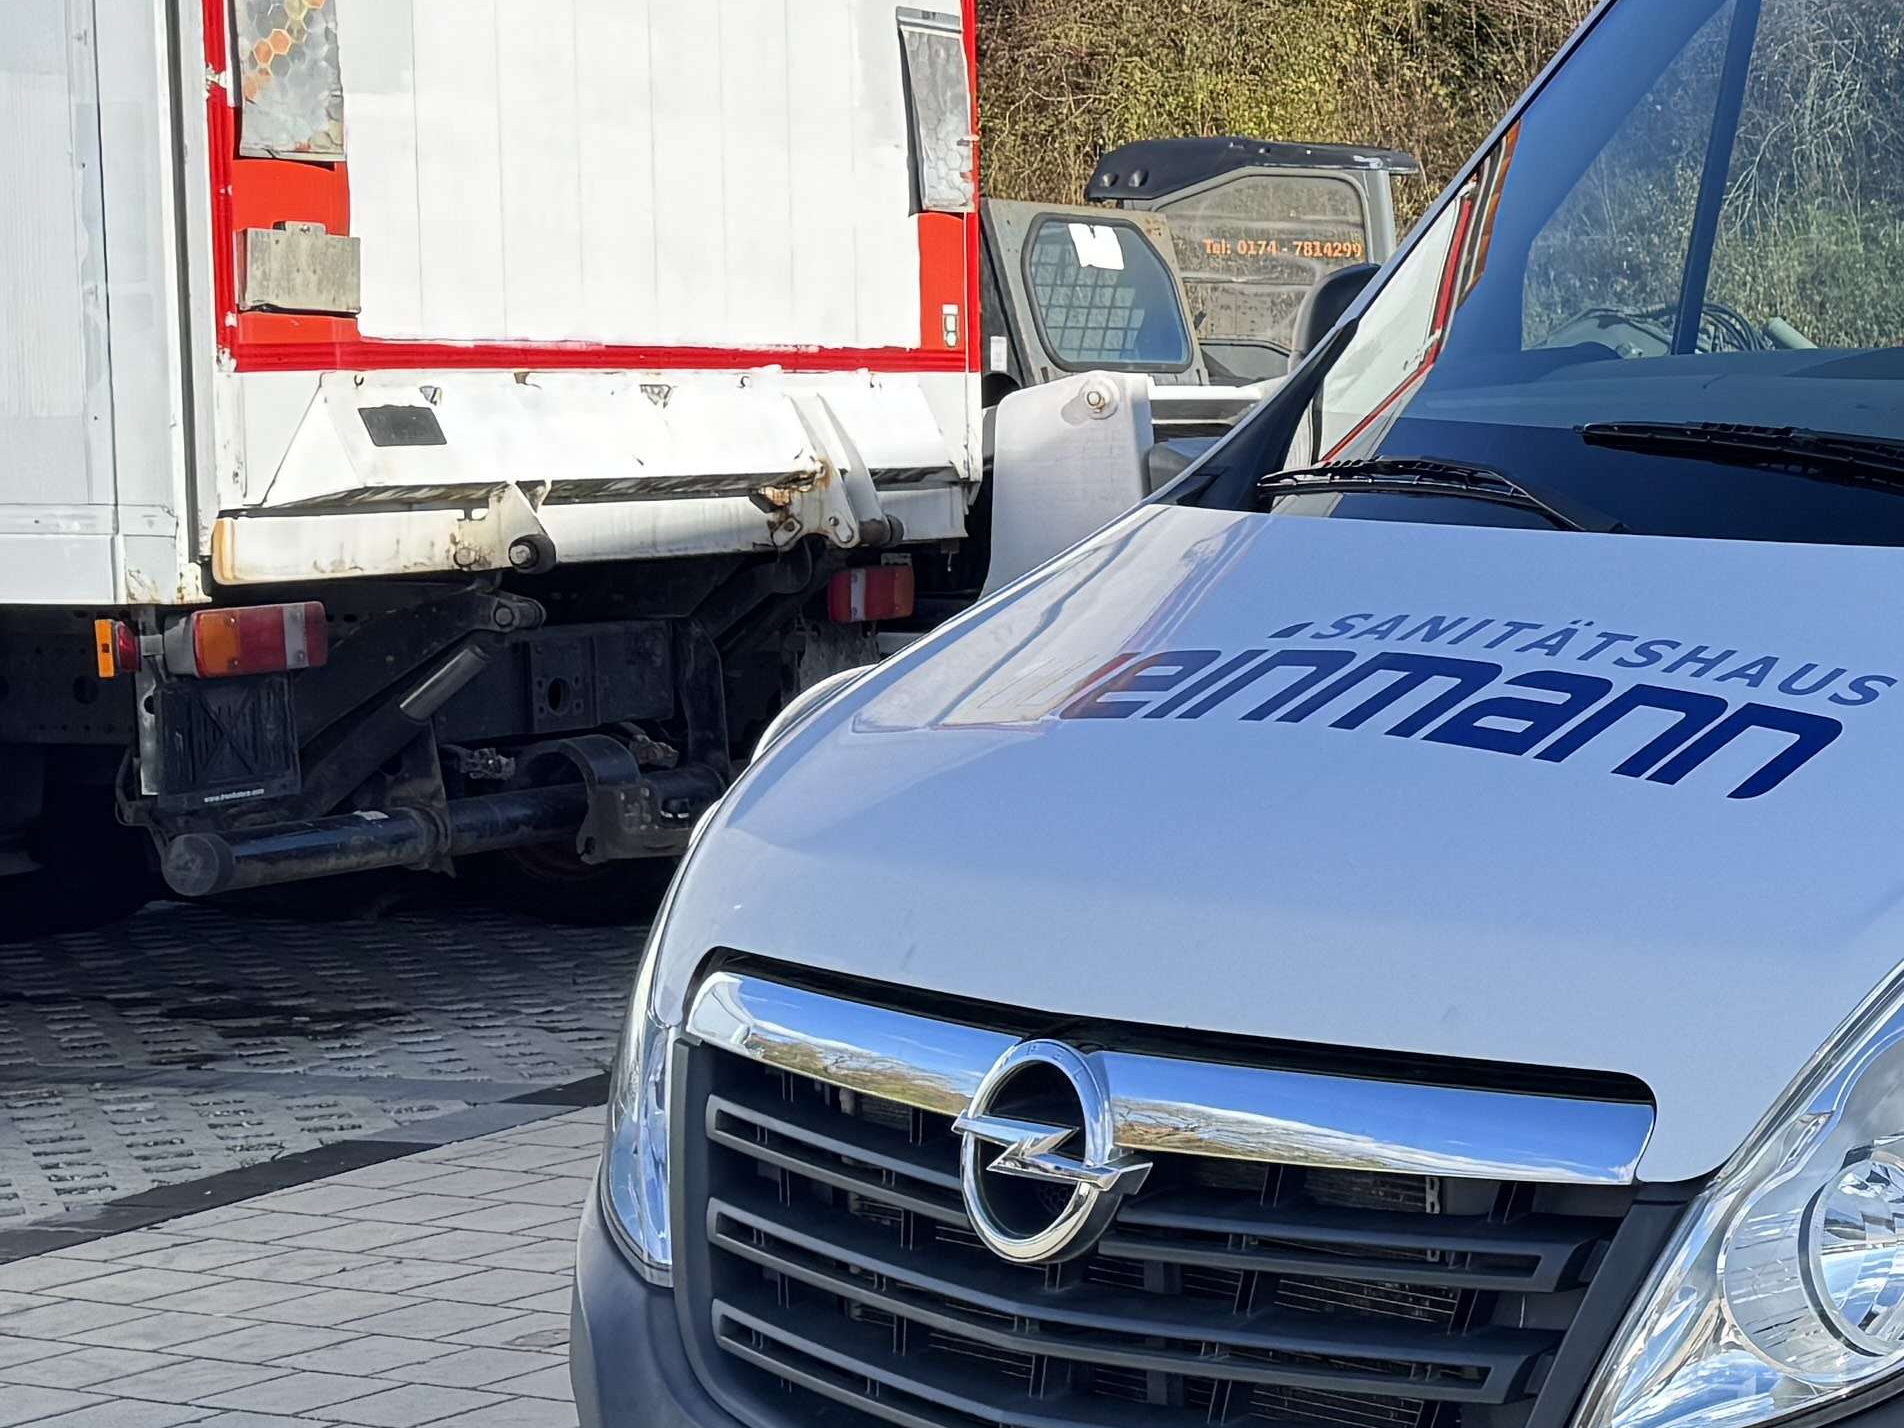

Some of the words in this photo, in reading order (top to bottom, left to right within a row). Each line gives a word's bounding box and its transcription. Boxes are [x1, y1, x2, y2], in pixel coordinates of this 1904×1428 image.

[1203, 239, 1231, 255] Tel:
[1237, 240, 1278, 256] 0174
[1314, 613, 1898, 707] SANITÄTSHAUS
